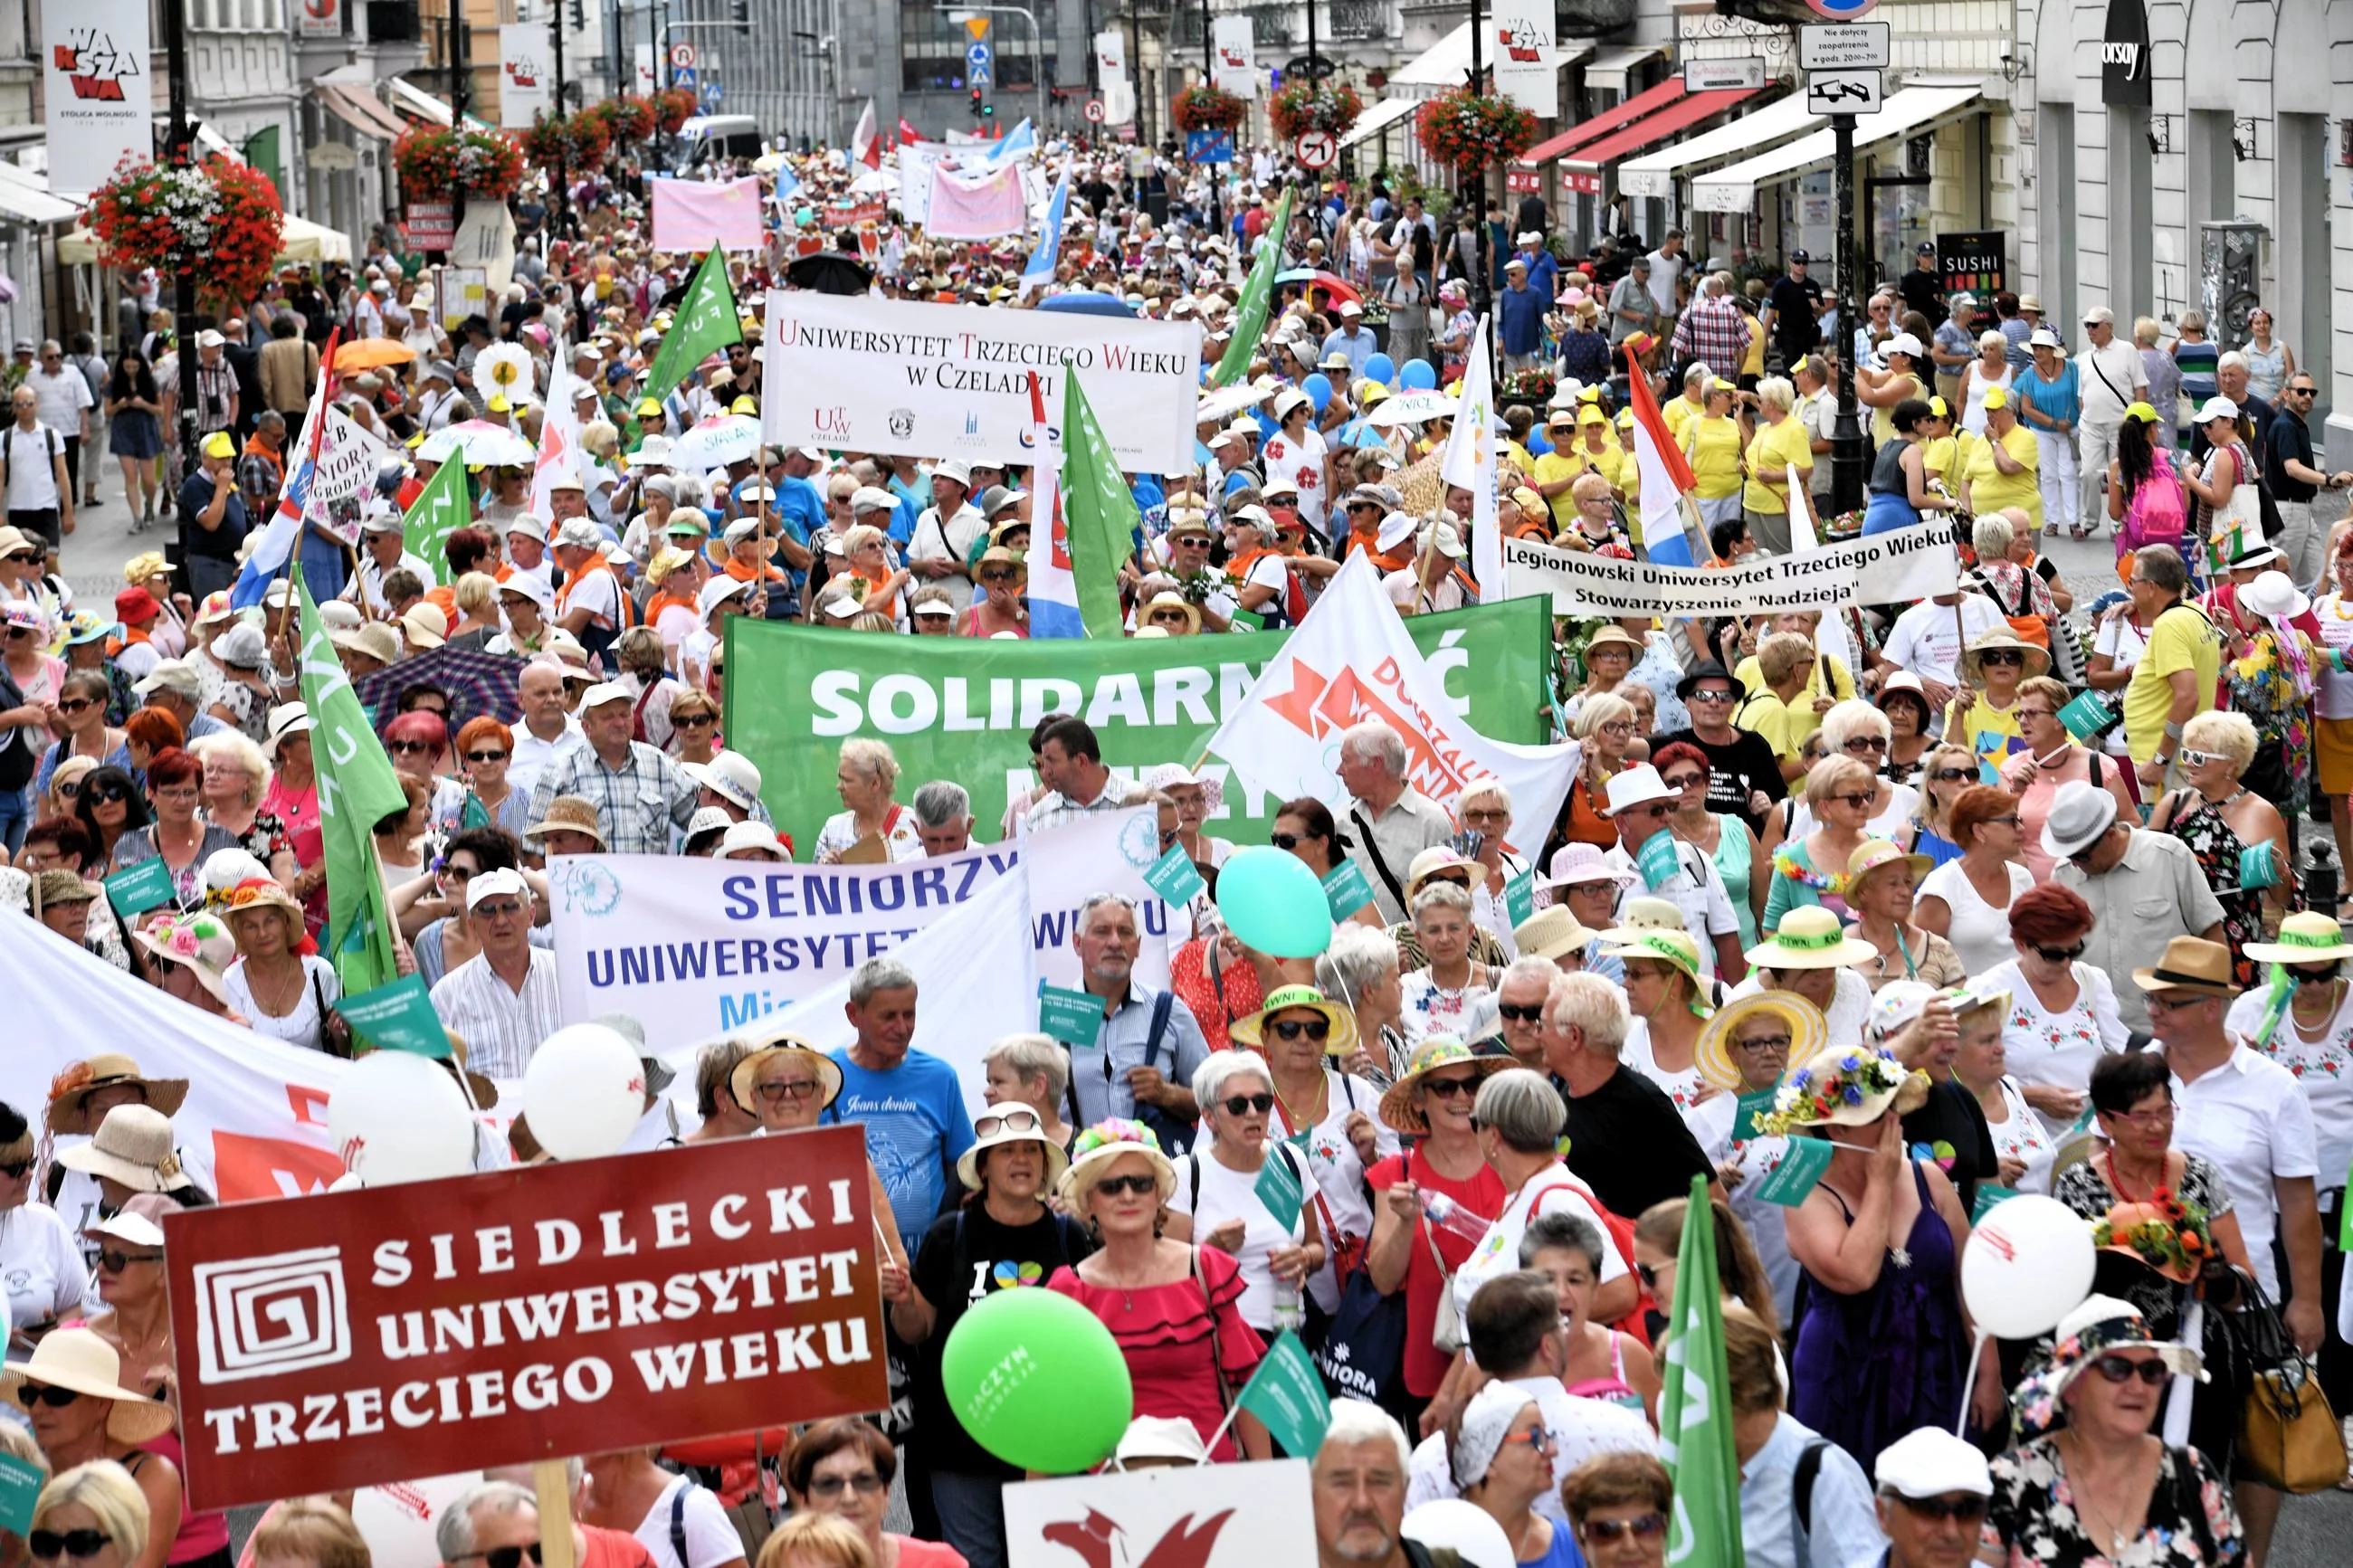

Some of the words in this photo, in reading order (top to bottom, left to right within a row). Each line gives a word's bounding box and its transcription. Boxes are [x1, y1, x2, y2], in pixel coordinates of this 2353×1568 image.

[1818, 41, 1869, 51] zaopatrzenia
[1840, 29, 1868, 37] dotyczy
[2101, 42, 2139, 81] orsay
[60, 110, 93, 119] STOLICA
[95, 109, 138, 119] WOLNOŚCI
[1946, 255, 1998, 271] SUSHI
[778, 318, 952, 358] UNIWERSYTET
[958, 332, 1093, 369] TRZECIEGO
[1101, 342, 1187, 375] WIEKU
[1506, 545, 1635, 583] Legionowski
[1643, 566, 1774, 589] Uniwersytet
[1781, 546, 1881, 579] Trzeciego
[1888, 528, 1952, 558] Wieku
[1574, 586, 1742, 613] Stowarzyszenie
[1749, 581, 1860, 607] "Nadzieja"
[722, 850, 1020, 921] SENIORZY
[841, 1094, 880, 1116] Jeans
[881, 1096, 917, 1112] denim
[371, 1179, 854, 1288] SIEDLECKI
[968, 1259, 991, 1297] I
[376, 1249, 858, 1359] UNIWERSYTET
[204, 1355, 614, 1454] TRZECIEGO
[632, 1317, 872, 1393] WIEKU
[967, 1343, 1030, 1421] ZACZYN
